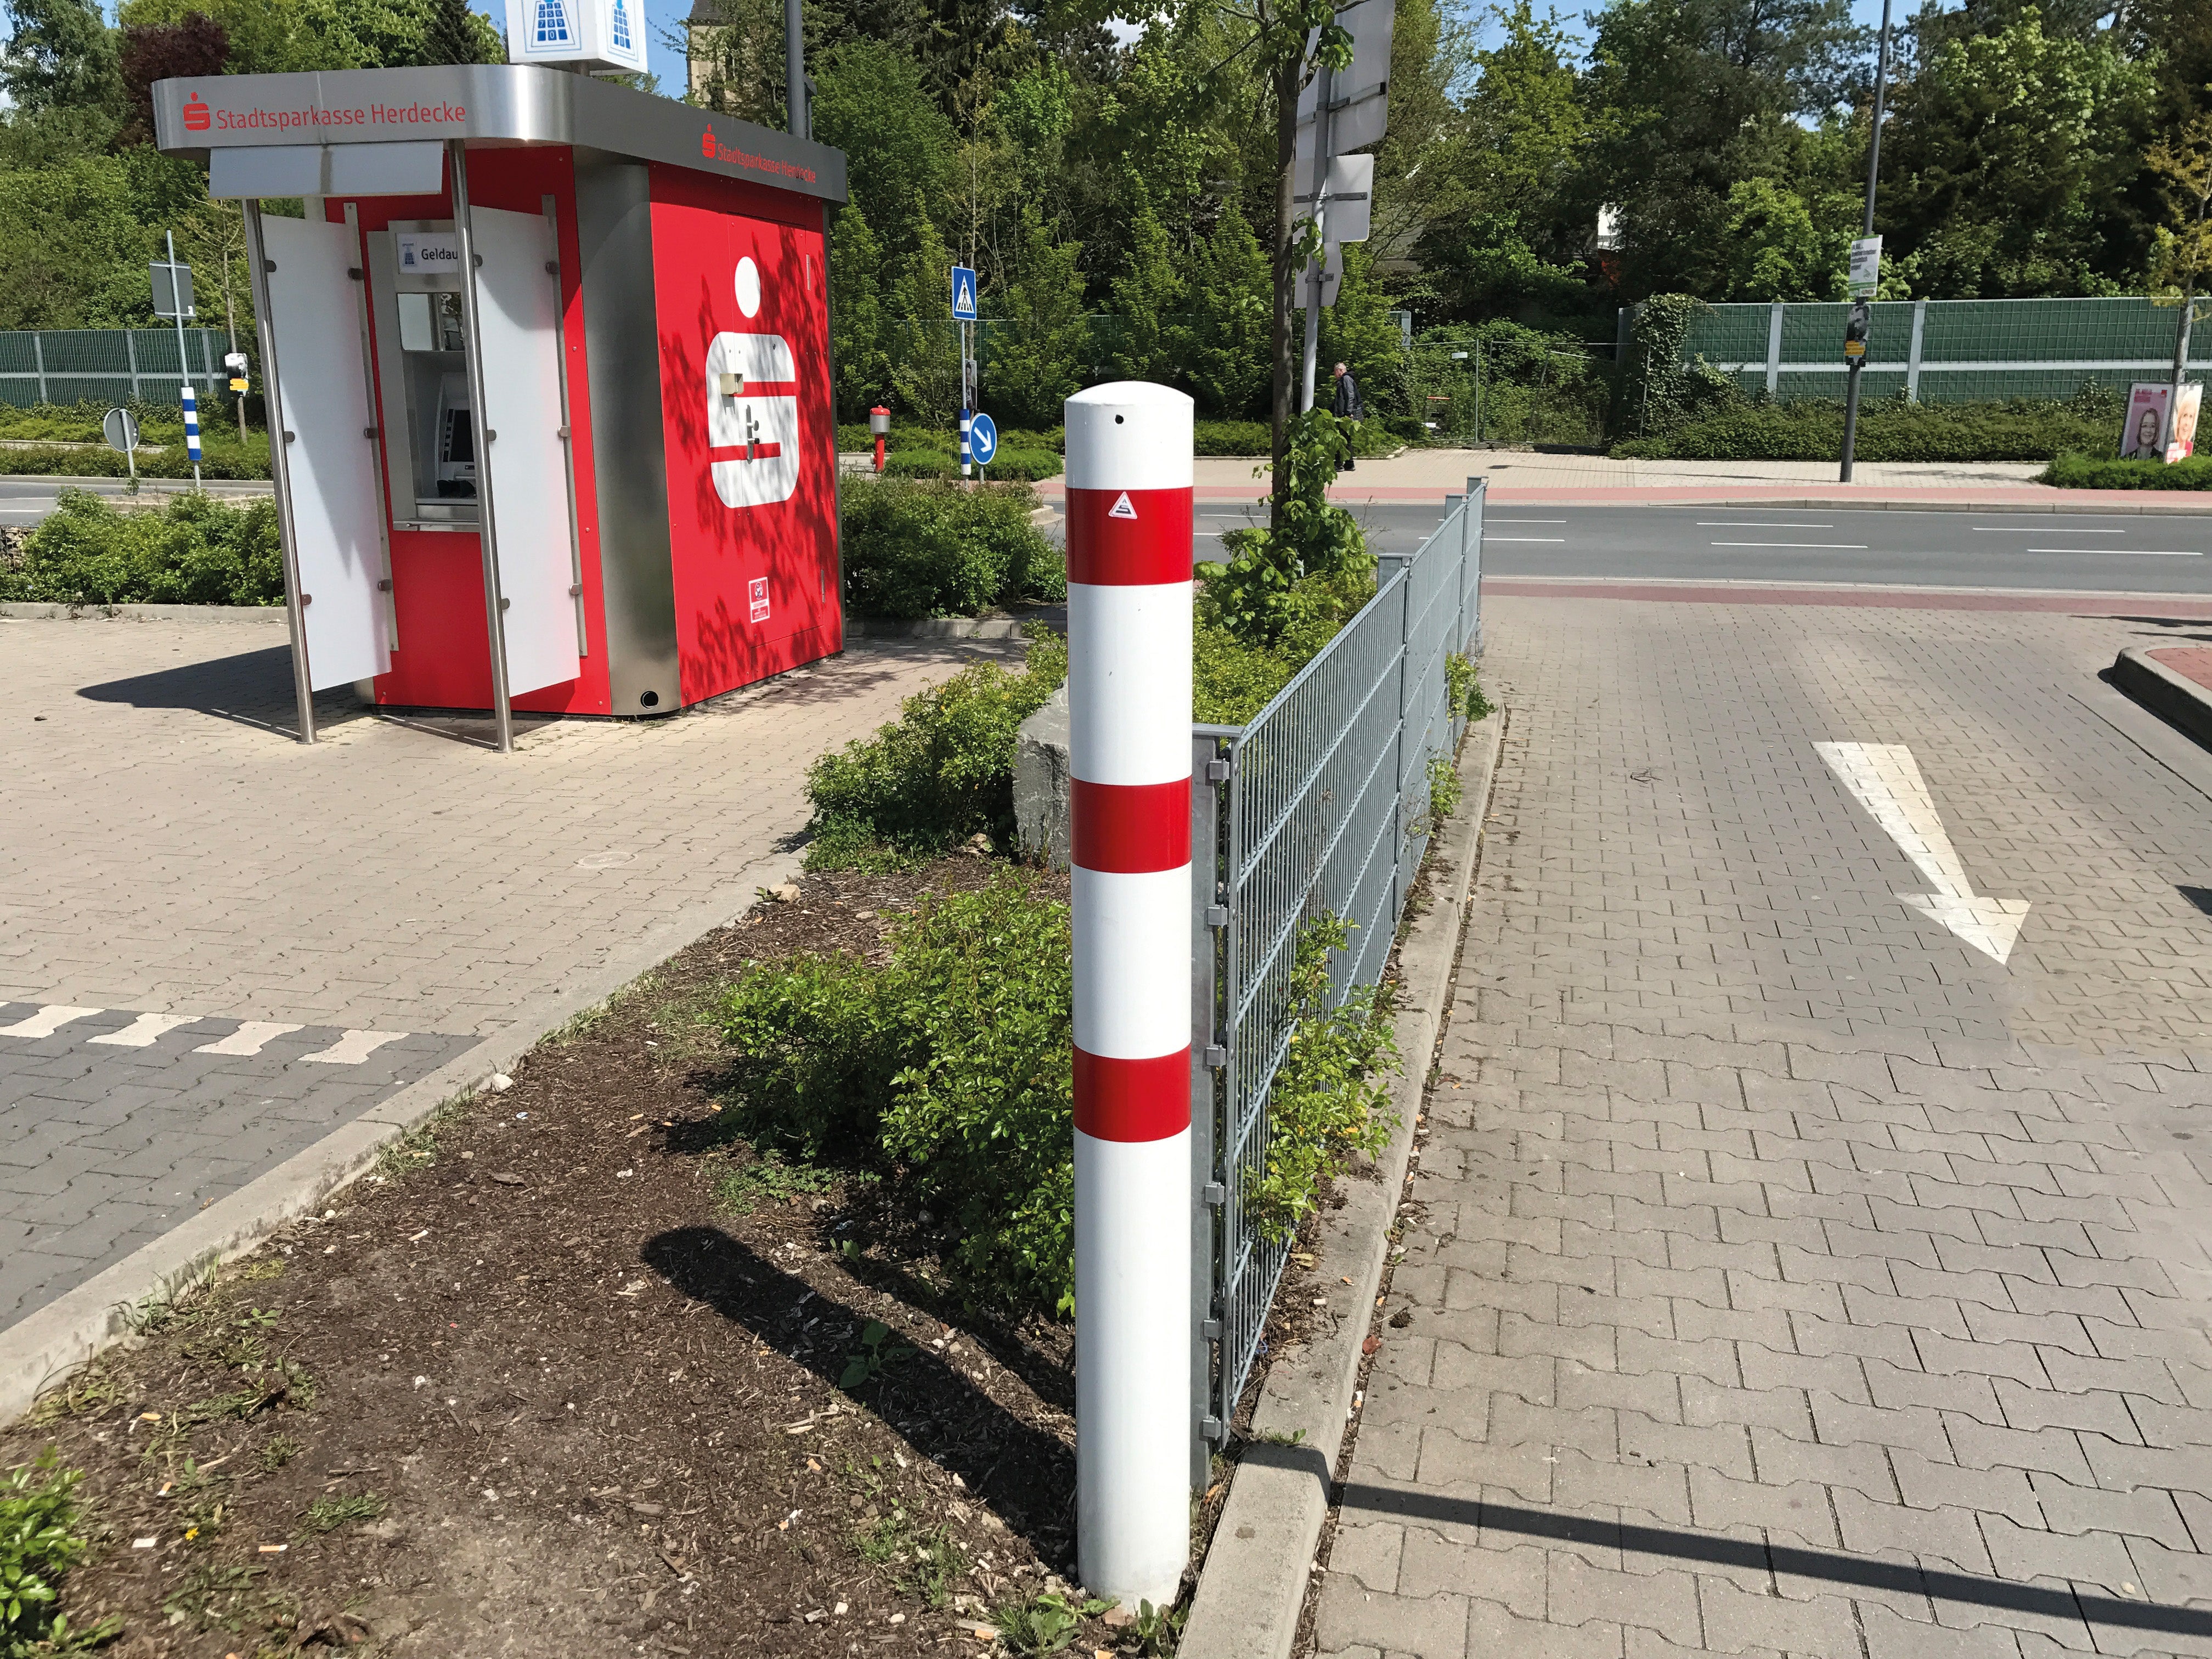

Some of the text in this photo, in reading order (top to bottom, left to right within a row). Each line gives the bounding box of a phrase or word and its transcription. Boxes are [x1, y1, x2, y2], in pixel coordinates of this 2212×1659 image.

[550, 31, 555, 39] 0
[217, 105, 365, 132] Stadtsparkasse
[371, 100, 466, 124] Herdecke
[718, 143, 780, 175] Stadtsparkasse
[781, 160, 816, 184] Herdecke
[421, 248, 458, 260] Geldau
